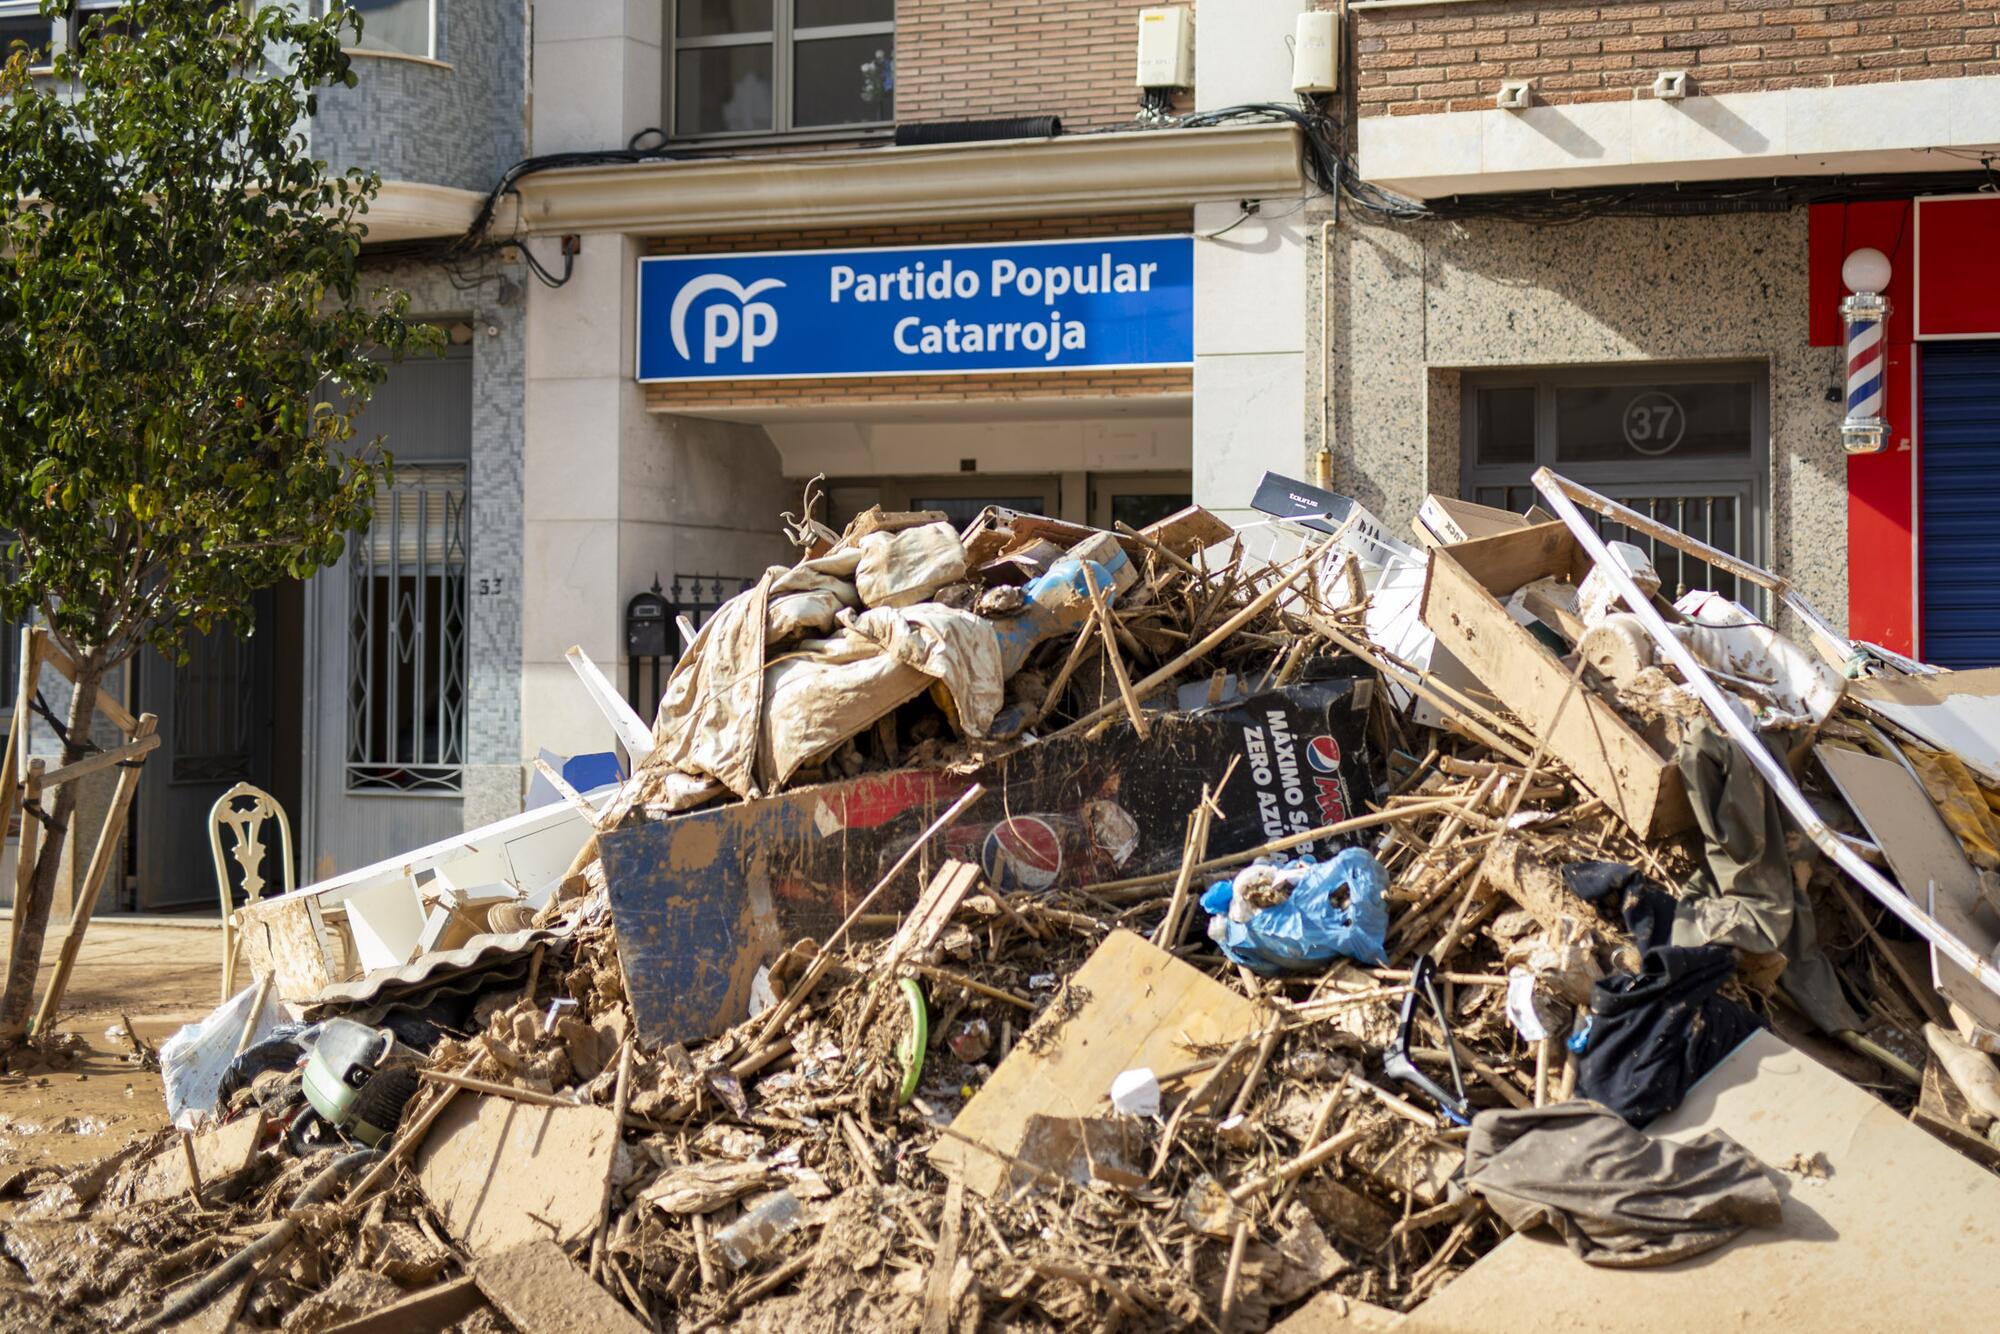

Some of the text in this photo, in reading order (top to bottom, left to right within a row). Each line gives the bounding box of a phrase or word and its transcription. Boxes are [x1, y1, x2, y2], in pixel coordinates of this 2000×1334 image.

[829, 252, 1158, 306] Partido Popular
[893, 310, 1087, 362] Catarroja
[1631, 405, 1675, 440] 37
[1289, 492, 1319, 508] taurus
[1242, 725, 1273, 786] ZERO
[1265, 710, 1305, 806] MÁXIMO
